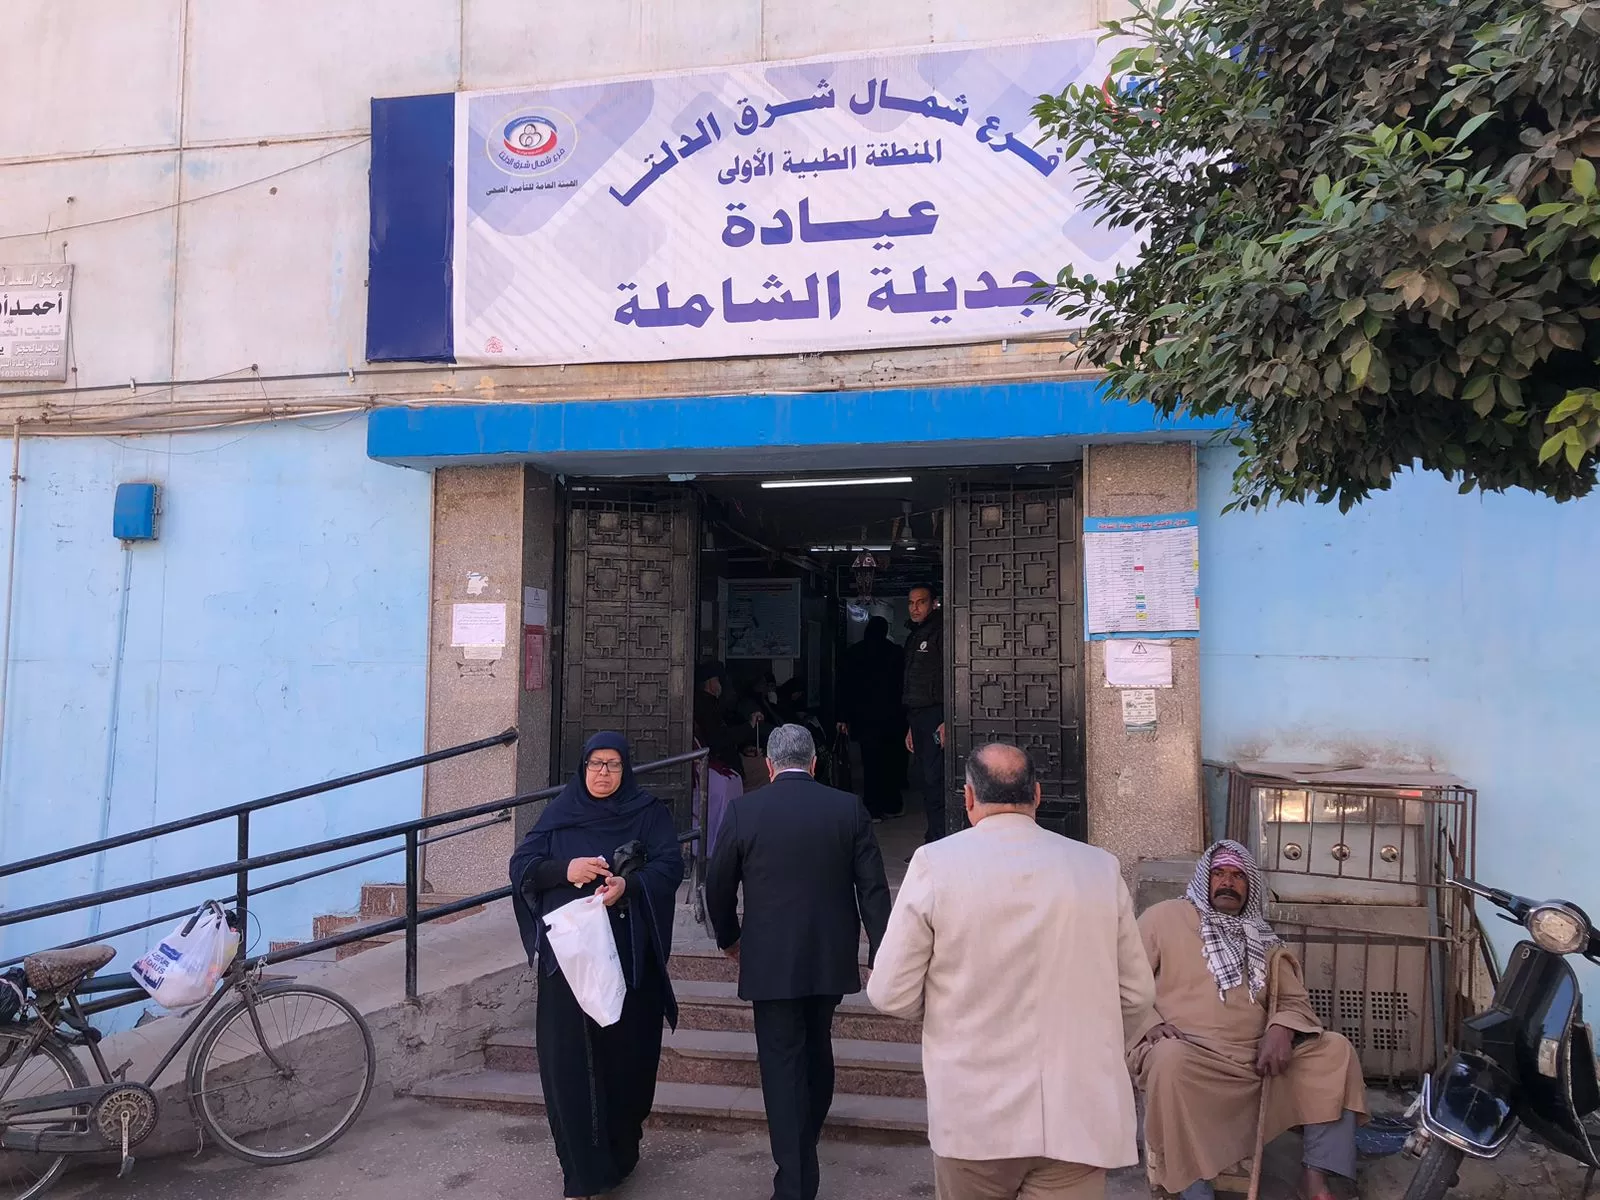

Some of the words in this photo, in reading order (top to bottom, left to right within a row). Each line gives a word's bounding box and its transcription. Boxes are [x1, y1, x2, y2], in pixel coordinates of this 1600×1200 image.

[734, 79, 835, 136] شرق
[849, 78, 969, 126] شمال
[513, 160, 531, 170] شرق
[530, 155, 552, 170] شمال
[608, 111, 721, 207] الدلتا
[717, 147, 774, 185] الأولى
[782, 145, 857, 179] الطبية
[865, 138, 942, 167] المنطقة
[976, 116, 1062, 177] فرع
[509, 182, 534, 195] للتأمين
[535, 181, 556, 191] العامة
[721, 196, 940, 251] عيادة
[613, 269, 840, 329] الشاملة
[866, 264, 1057, 326] جديلة
